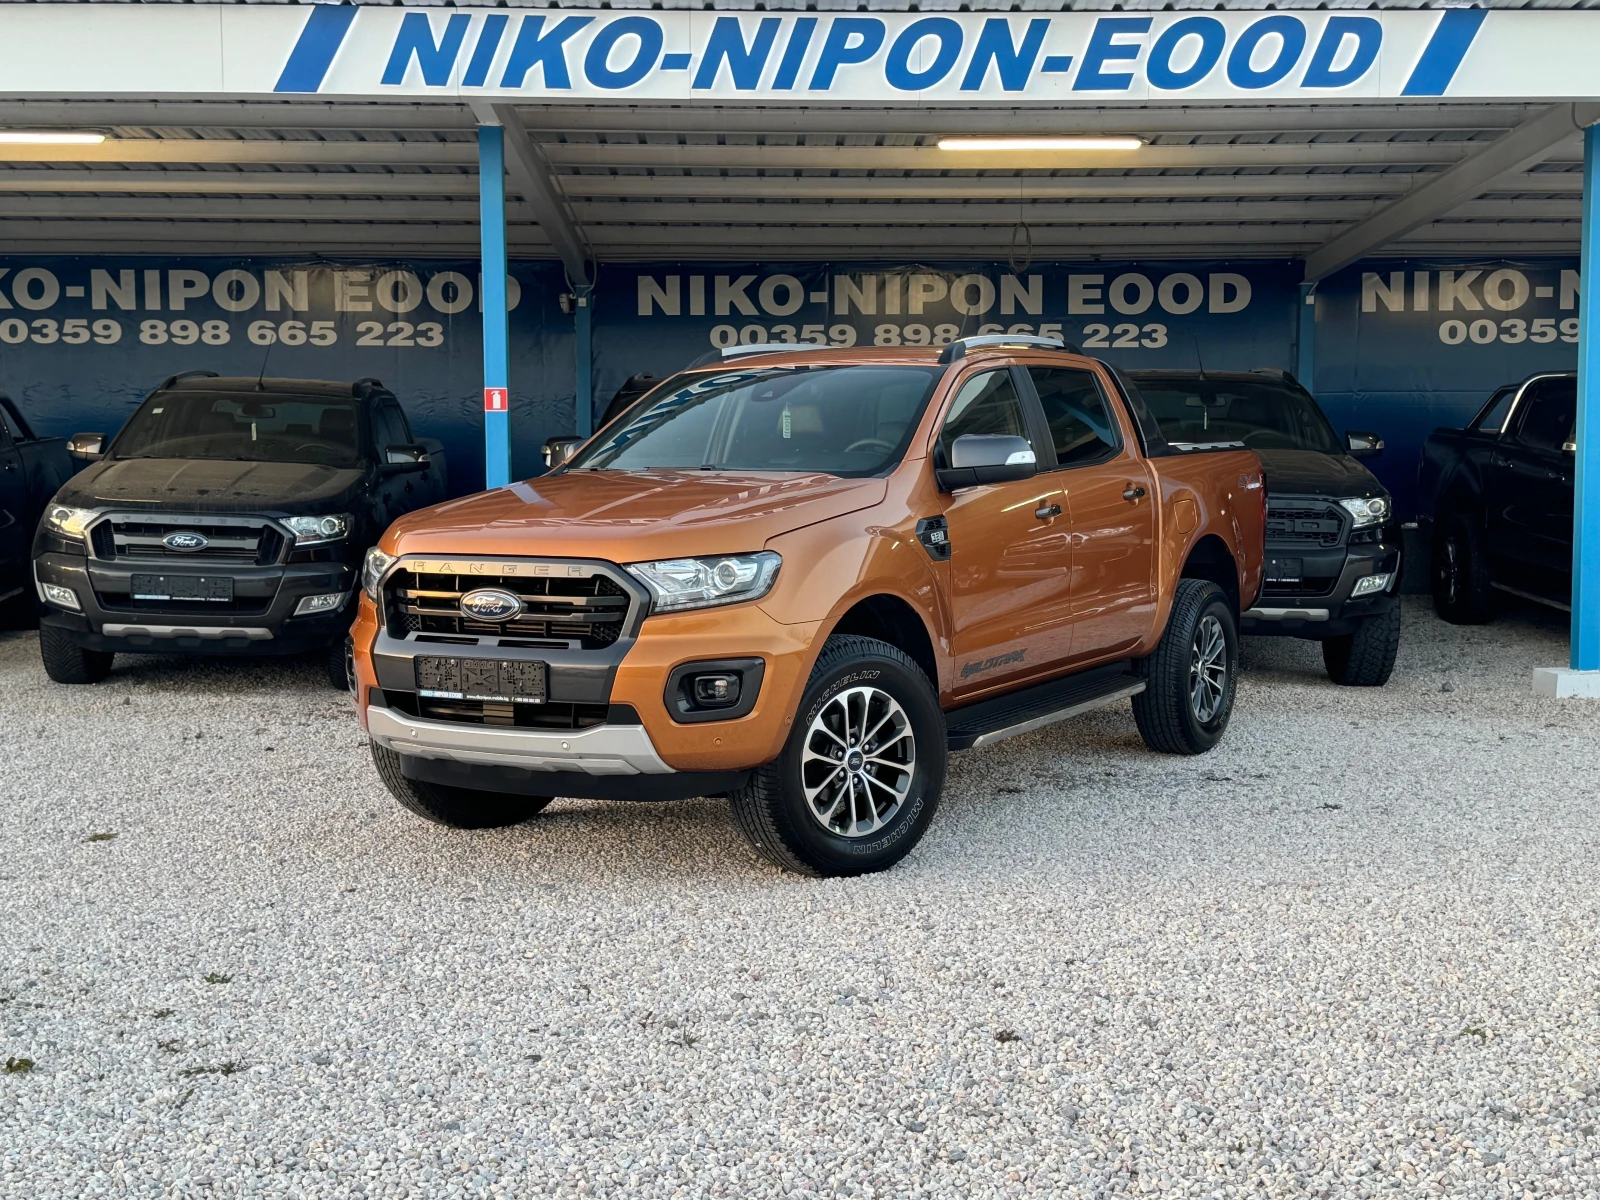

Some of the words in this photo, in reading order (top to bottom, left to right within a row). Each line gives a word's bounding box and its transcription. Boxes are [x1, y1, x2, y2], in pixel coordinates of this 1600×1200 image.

[381, 13, 1383, 91] NIKO-NIPON-EOOD
[0, 268, 309, 313] O-NIPON
[637, 273, 1043, 317] NIKO-NIPON
[1067, 272, 1253, 316] EOOD
[138, 319, 231, 346] 898
[247, 320, 338, 347] 665
[355, 321, 445, 348] 223
[709, 323, 857, 349] 00359
[873, 323, 960, 347] 898
[1082, 323, 1169, 349] 223
[1438, 318, 1579, 345] 00359
[412, 561, 584, 577] RANGER
[471, 596, 503, 614] Ford
[805, 669, 881, 727] MICHELIN
[852, 797, 925, 856] MICHELIN
